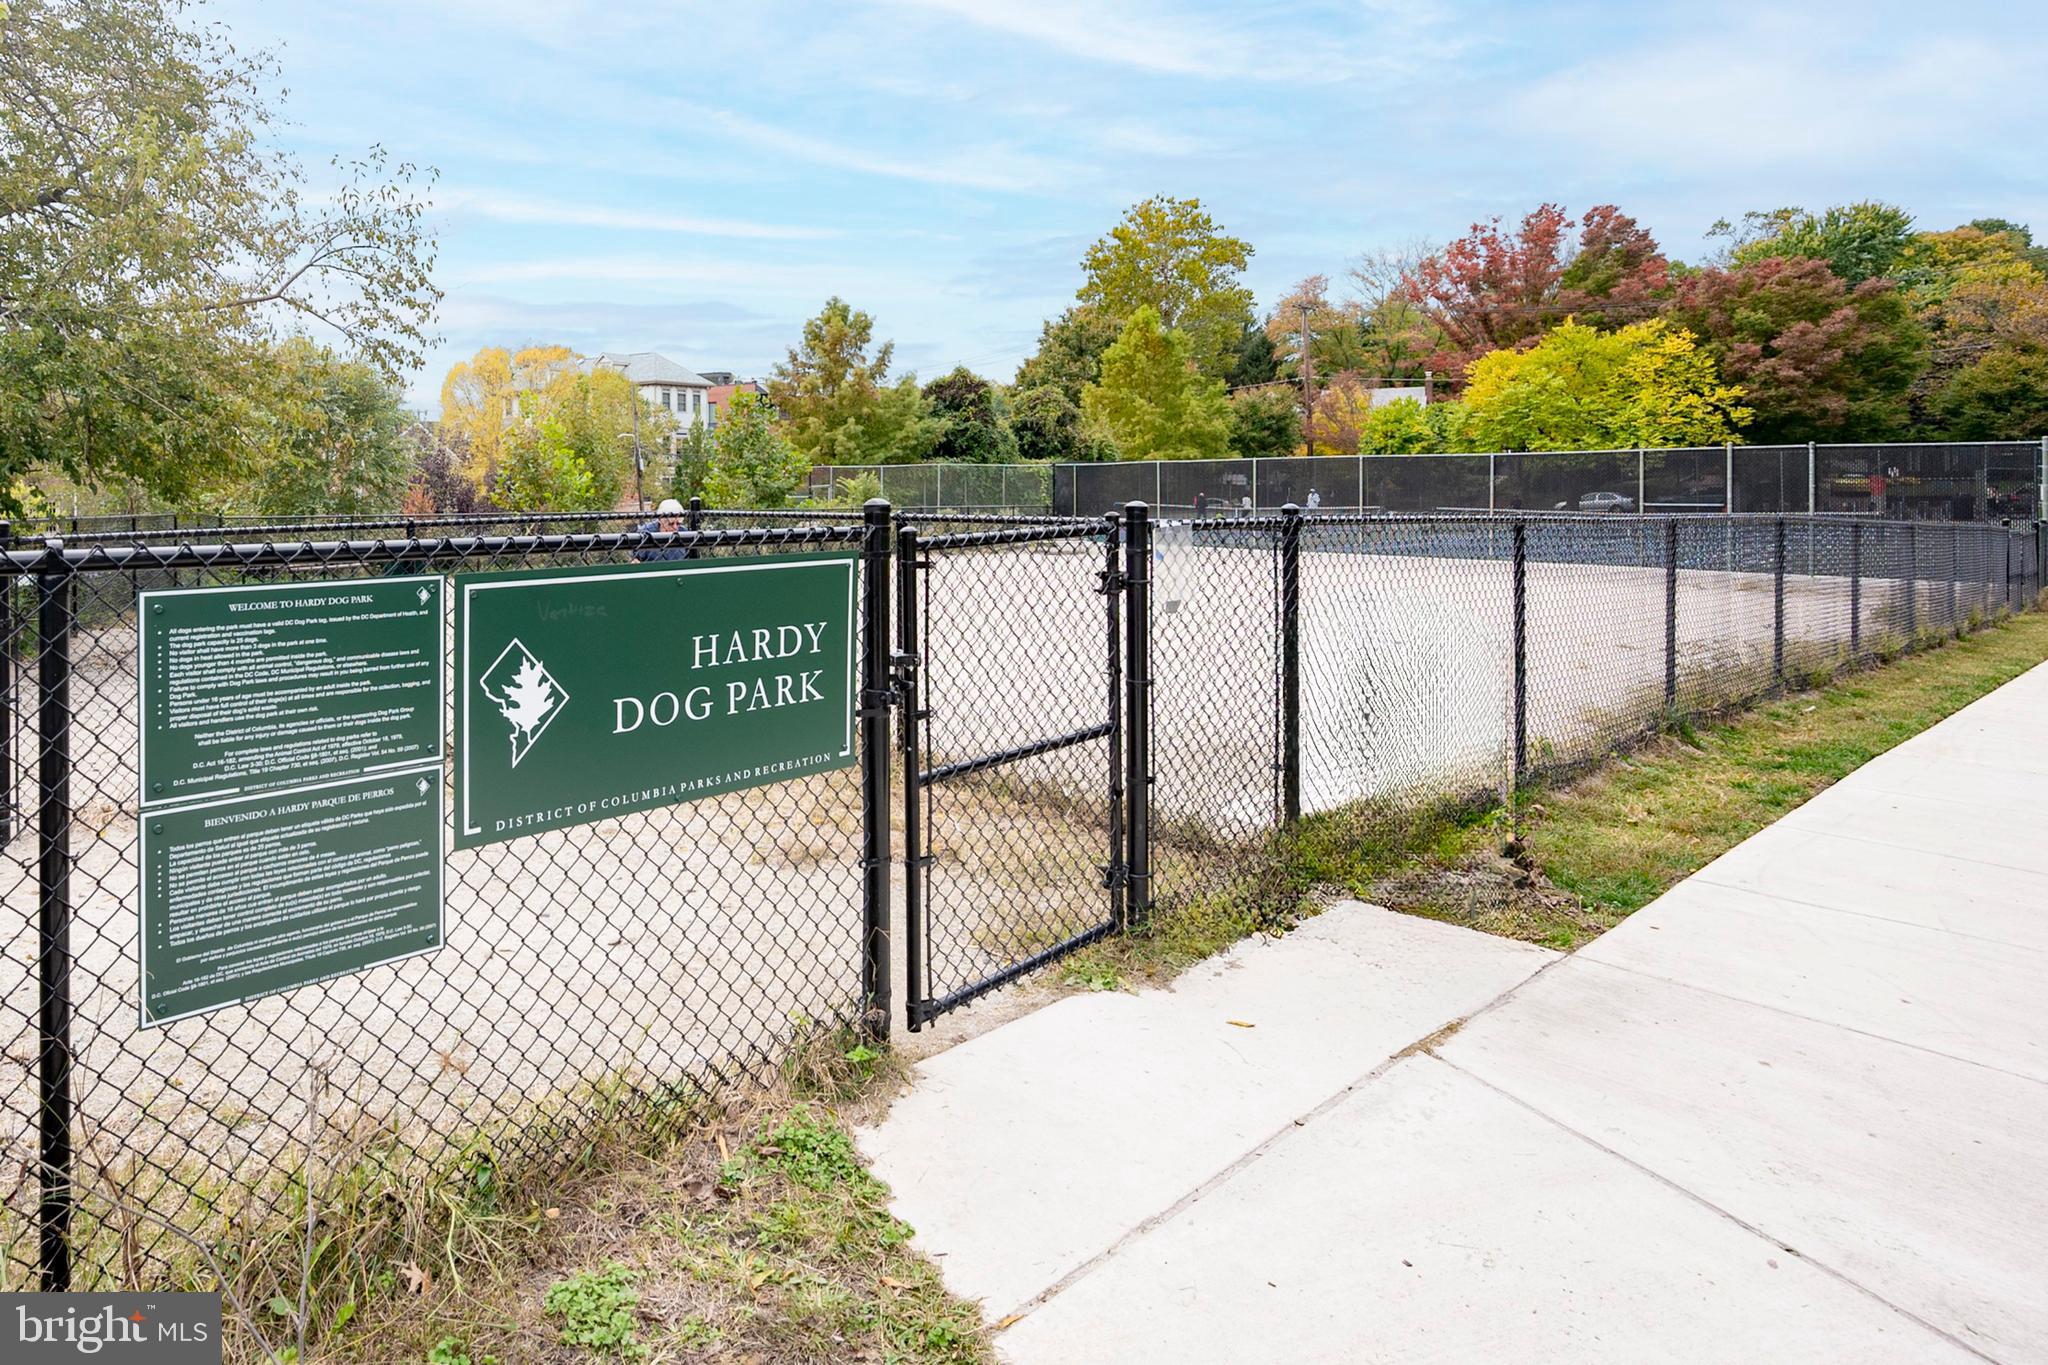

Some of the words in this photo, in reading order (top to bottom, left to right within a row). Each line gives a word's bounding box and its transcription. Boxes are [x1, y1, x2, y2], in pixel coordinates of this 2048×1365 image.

[228, 601, 279, 612] WELCOME
[280, 600, 293, 609] TO
[295, 598, 327, 608] HARDY
[328, 597, 349, 606] DOG
[351, 595, 373, 604] PARK
[691, 622, 827, 669] HARDY
[612, 687, 713, 734] DOG
[727, 670, 824, 715] PARK
[204, 809, 267, 828] BIENVENIDO
[269, 808, 276, 817] A
[278, 802, 310, 815] HARDY
[312, 796, 346, 811] PARQUE
[348, 793, 361, 803] DE
[363, 788, 394, 800] PERROS
[496, 805, 572, 832] DISTRICT
[578, 800, 597, 814] OF
[601, 785, 675, 809] COLUMBIA
[680, 776, 721, 793] PARKS
[725, 769, 751, 783] AND
[755, 753, 831, 777] RECREATION
